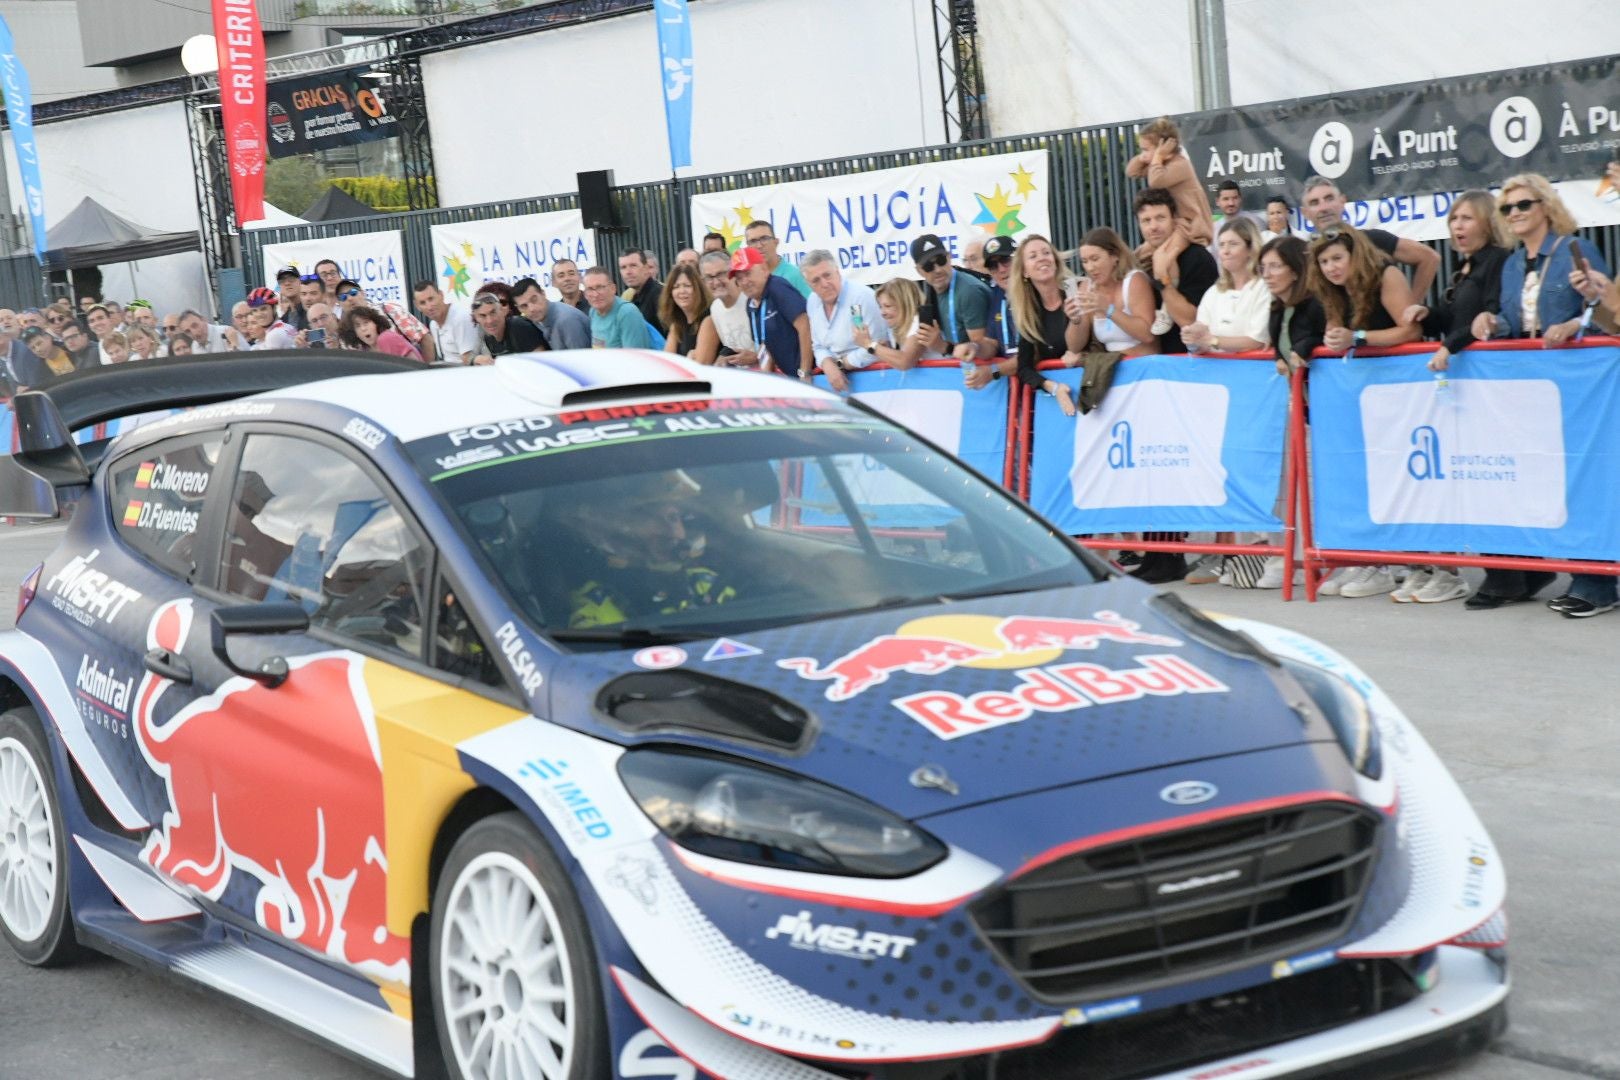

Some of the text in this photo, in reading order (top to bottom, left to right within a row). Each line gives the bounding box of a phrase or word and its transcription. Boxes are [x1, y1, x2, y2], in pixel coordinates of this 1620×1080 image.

[225, 0, 255, 105] CRITERI
[292, 84, 349, 111] GRACIAS
[1558, 102, 1580, 138] À
[1369, 125, 1459, 160] À Punt
[1206, 146, 1286, 178] À Punt
[480, 246, 504, 272] LA
[841, 246, 871, 270] DEL
[448, 415, 553, 447] FORD
[664, 417, 706, 433] ALL
[718, 411, 786, 427] LIVE
[1151, 457, 1190, 467] ALICANTE
[1450, 453, 1516, 466] DIPUTACIÓN
[1451, 470, 1517, 481] DE ALICANTE
[150, 463, 209, 494] C.Moreno
[137, 501, 199, 534] D.Fuentes
[495, 620, 544, 698] PULSAR
[76, 653, 134, 713] Admiral
[75, 696, 128, 739] SEGUROS
[553, 781, 612, 839] IMED
